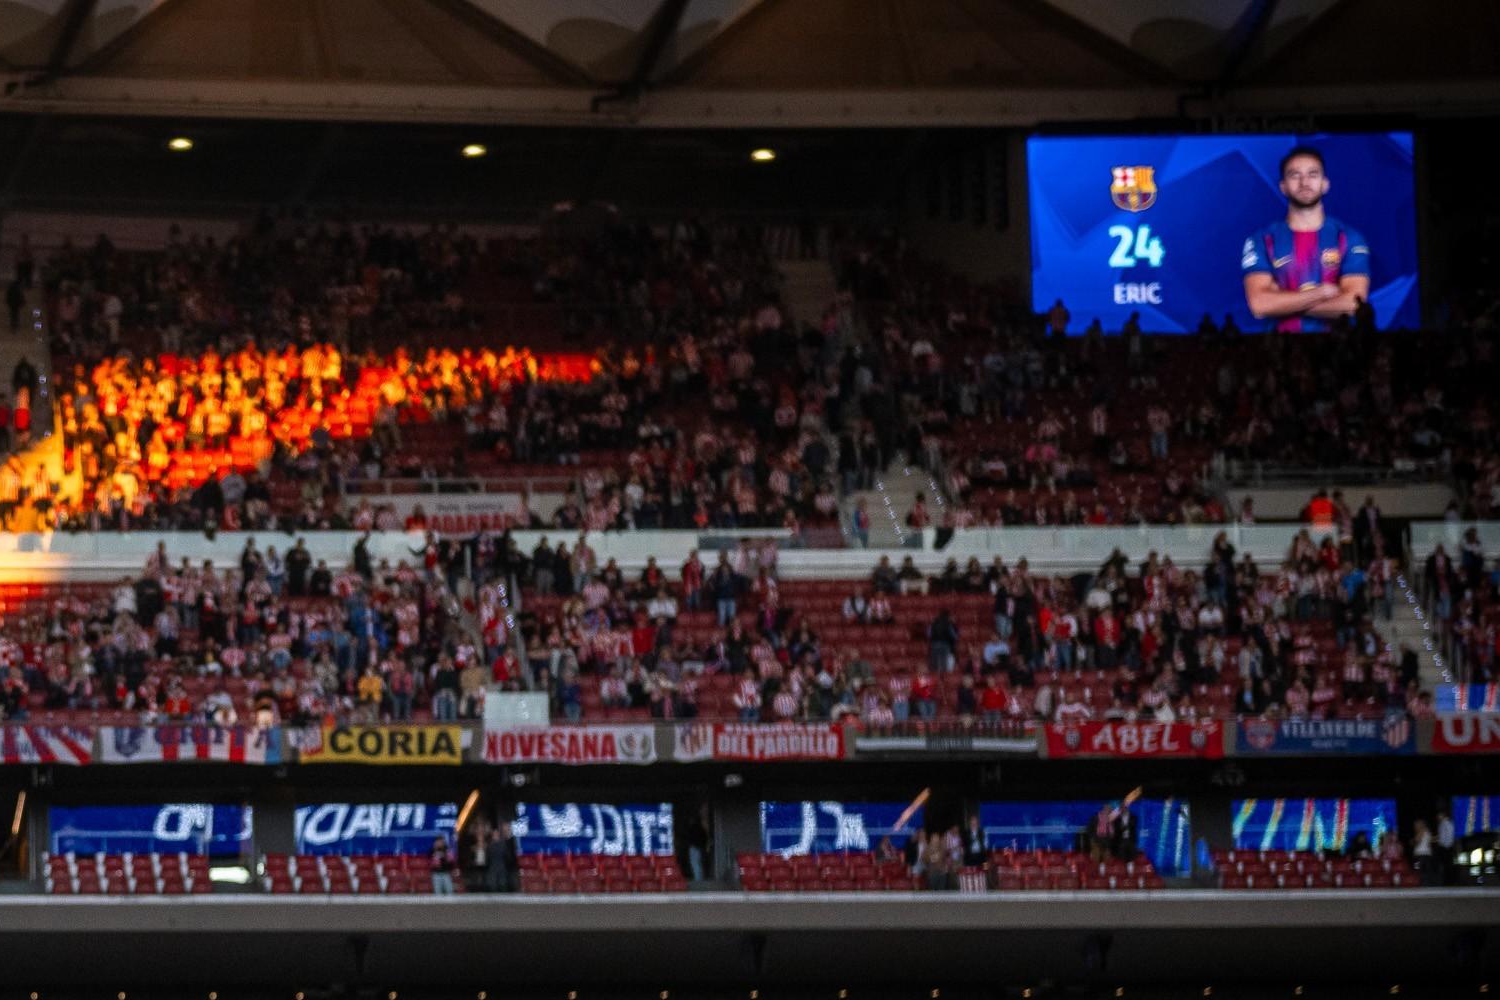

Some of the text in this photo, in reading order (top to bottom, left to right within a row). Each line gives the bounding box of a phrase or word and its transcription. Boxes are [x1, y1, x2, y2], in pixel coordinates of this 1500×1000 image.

[1108, 225, 1165, 268] 24
[1114, 283, 1162, 304] ERIC
[329, 729, 457, 757] CORIA
[1092, 722, 1180, 754] ABEL
